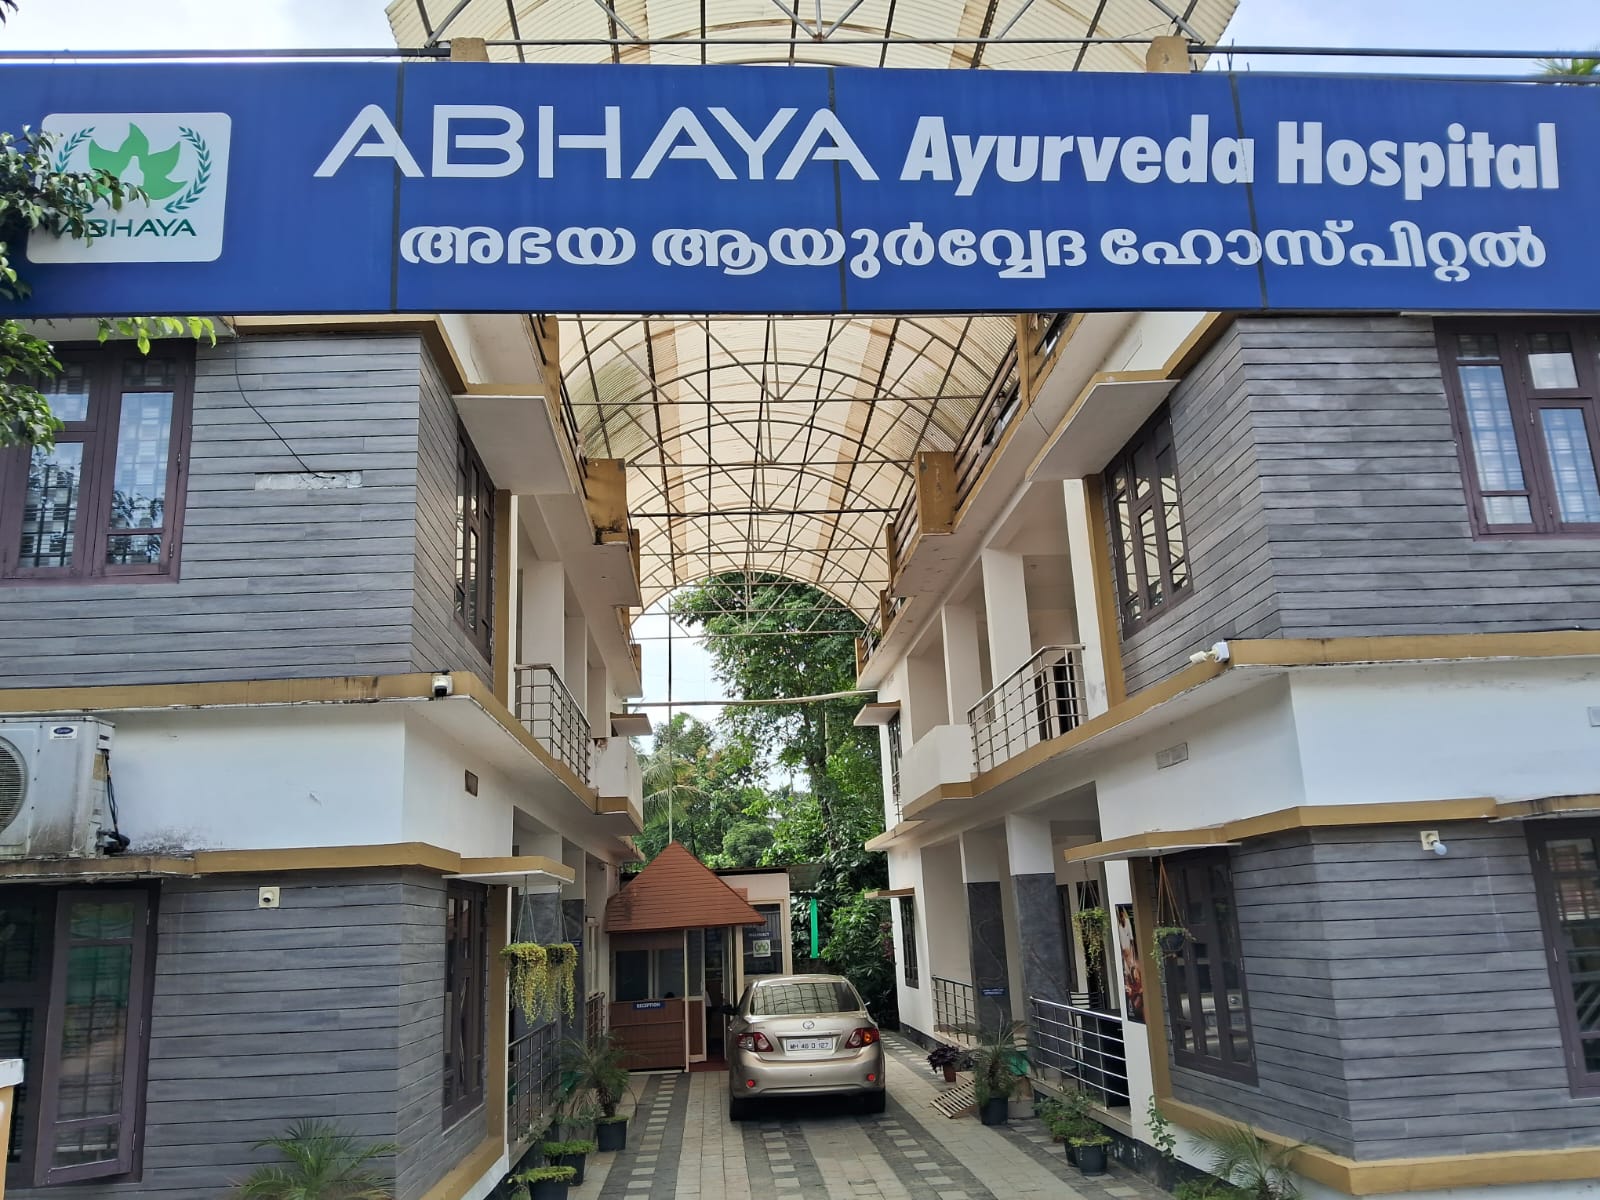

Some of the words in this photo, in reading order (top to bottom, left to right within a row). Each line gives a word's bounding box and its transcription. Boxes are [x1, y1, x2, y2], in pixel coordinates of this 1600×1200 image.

[313, 103, 880, 181] ABHAYA
[899, 114, 1255, 196] Ayurveda
[1278, 121, 1560, 202] Hospital
[399, 225, 636, 266] അഭയ
[651, 221, 1087, 279] ആയുർവ്വേദ
[1100, 219, 1547, 282] ഹോസ്പിറ്റൽ
